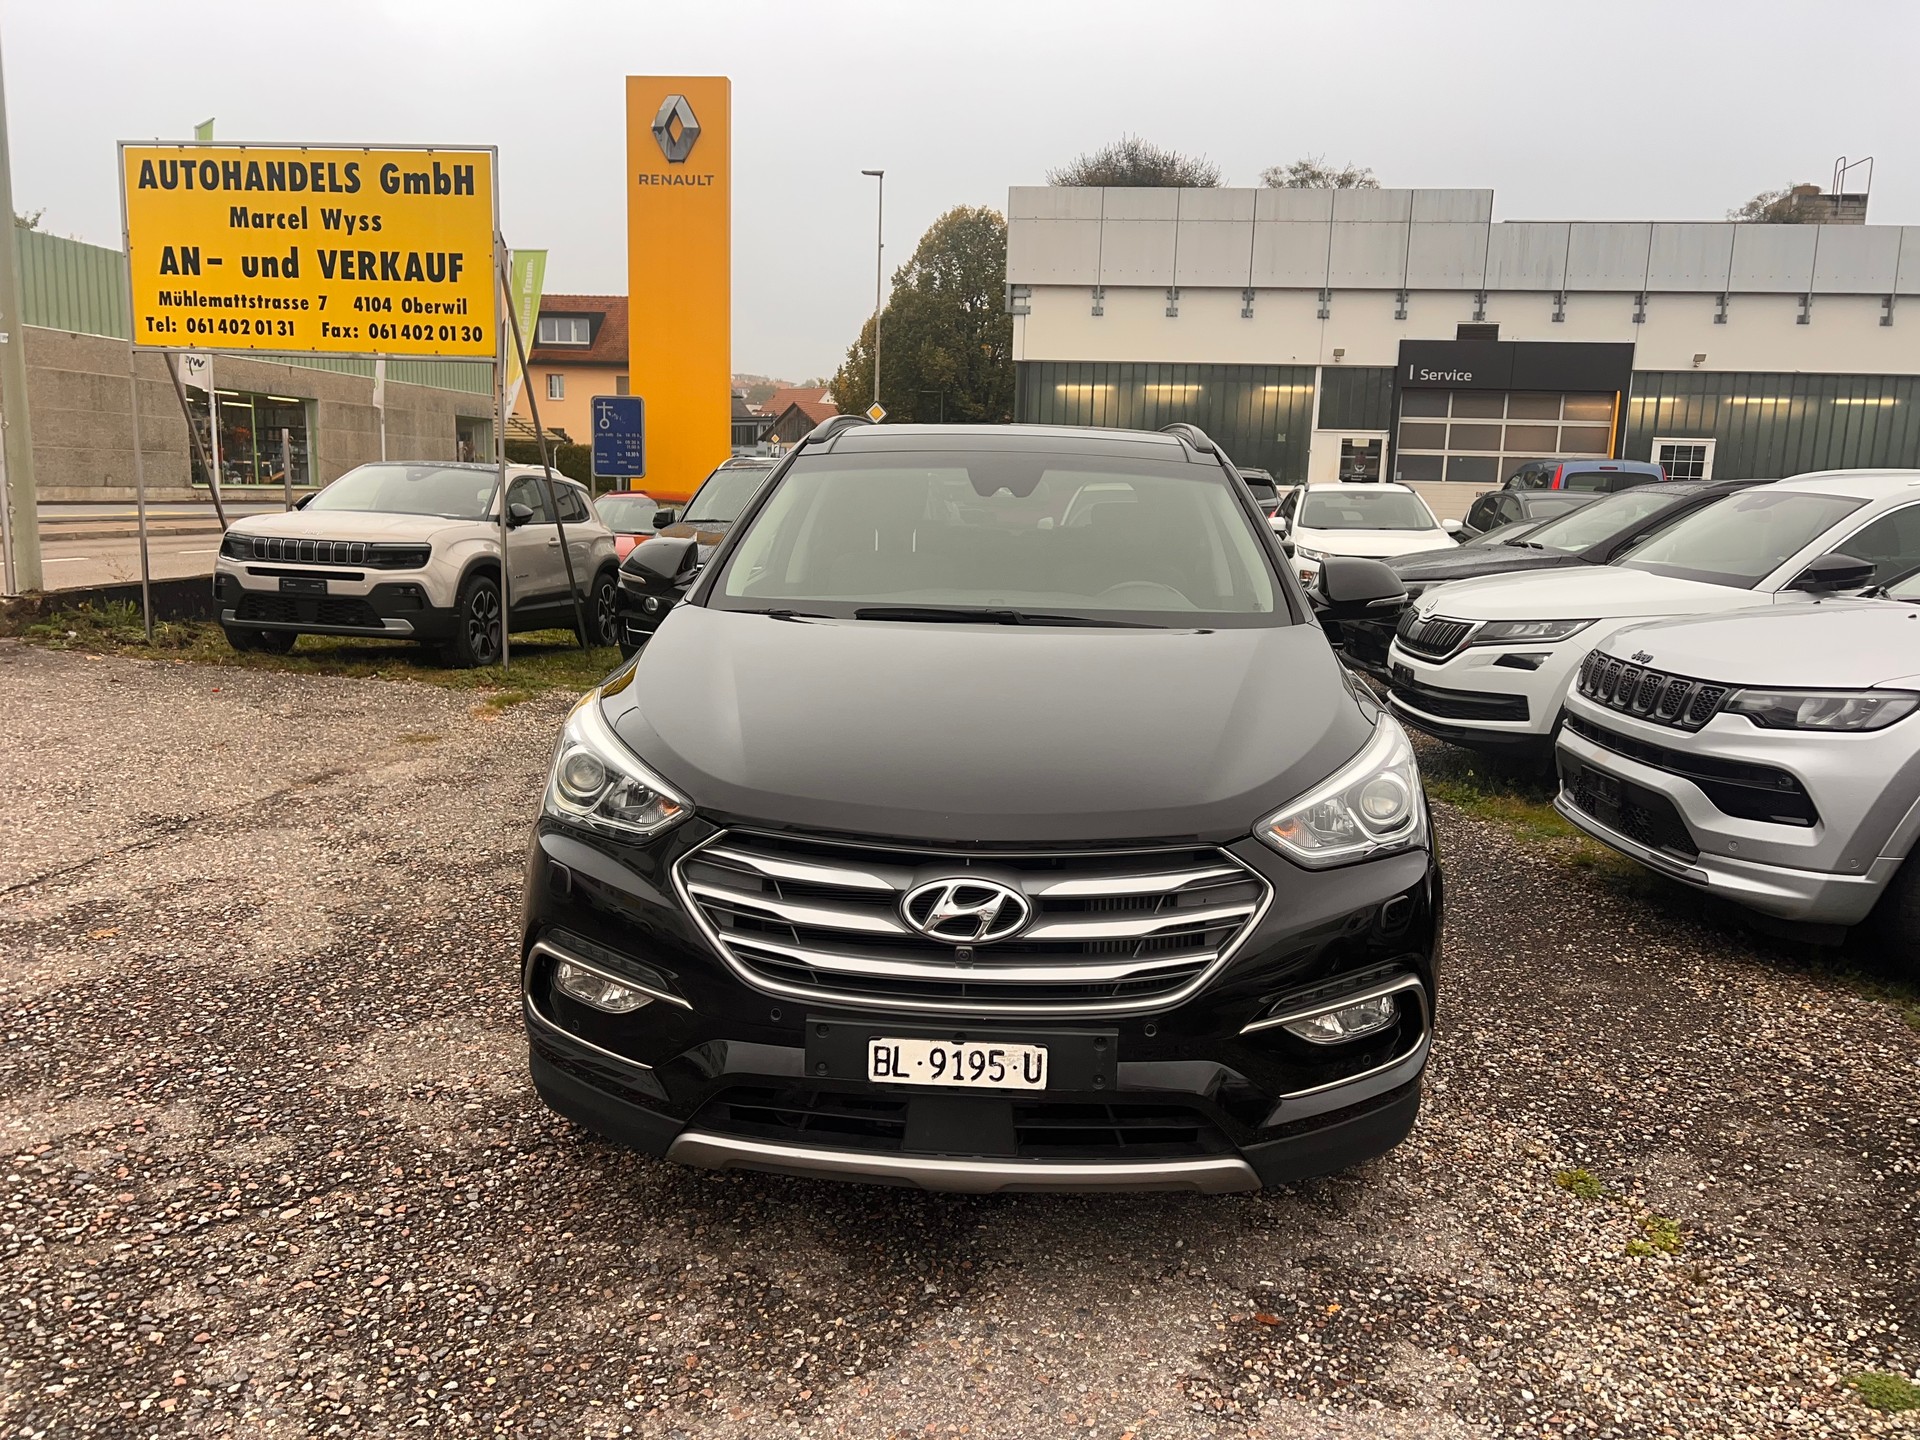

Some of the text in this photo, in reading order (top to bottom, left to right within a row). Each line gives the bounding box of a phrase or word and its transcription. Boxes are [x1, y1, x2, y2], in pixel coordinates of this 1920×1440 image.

[138, 159, 475, 196] AUTOHANDELS GmbH
[638, 173, 715, 186] RENAULT
[229, 206, 382, 236] Marcel Wyss
[241, 246, 300, 279] und
[316, 249, 464, 283] VERKAUF
[158, 289, 468, 315] Mühlemattstrasse 7 4104 Oberwil
[145, 316, 177, 333] Tel:
[322, 321, 359, 339] Fax:
[1419, 368, 1473, 382] Service
[1631, 649, 1654, 665] Jeep
